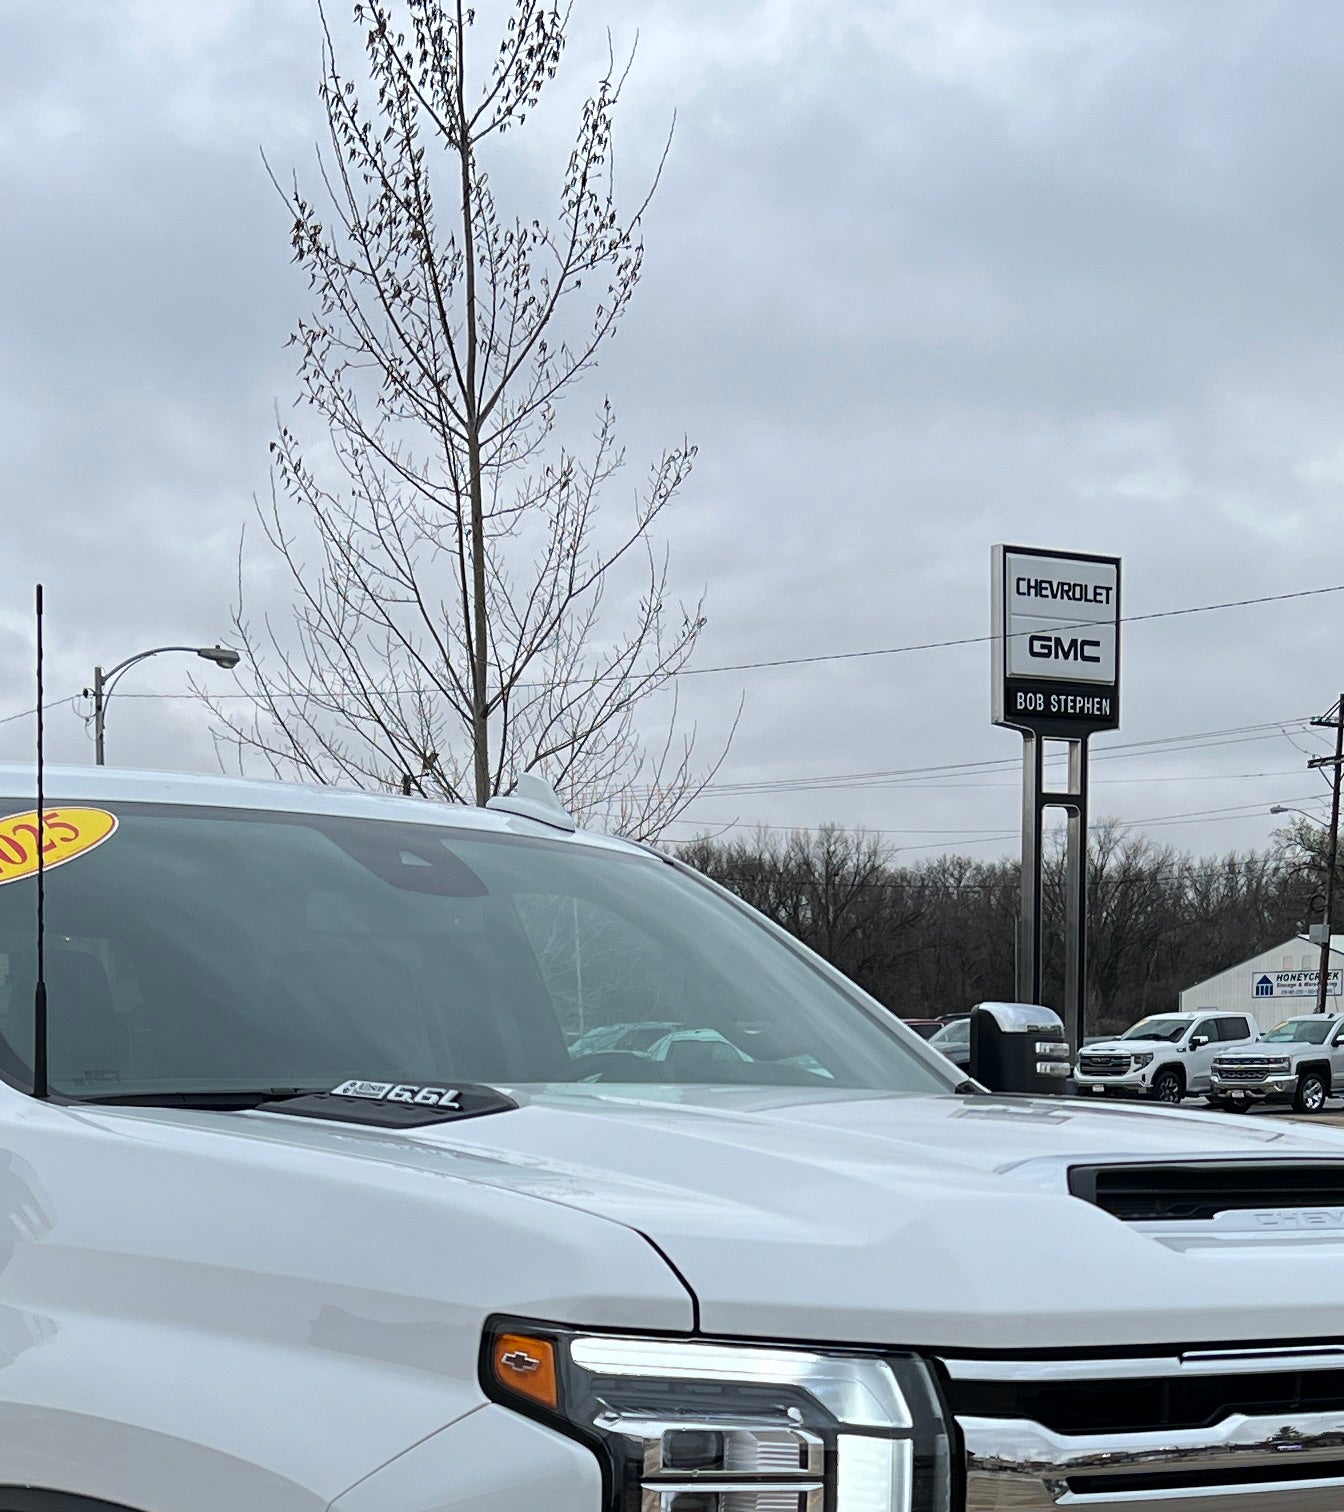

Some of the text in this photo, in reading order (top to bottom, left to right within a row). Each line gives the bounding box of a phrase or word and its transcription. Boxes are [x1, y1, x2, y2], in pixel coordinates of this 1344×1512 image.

[1016, 577, 1113, 605] CHEVROLET
[1028, 634, 1101, 663] GMC
[1016, 692, 1111, 716] BOB STEPHEN
[1276, 972, 1340, 982] HONEYCREK
